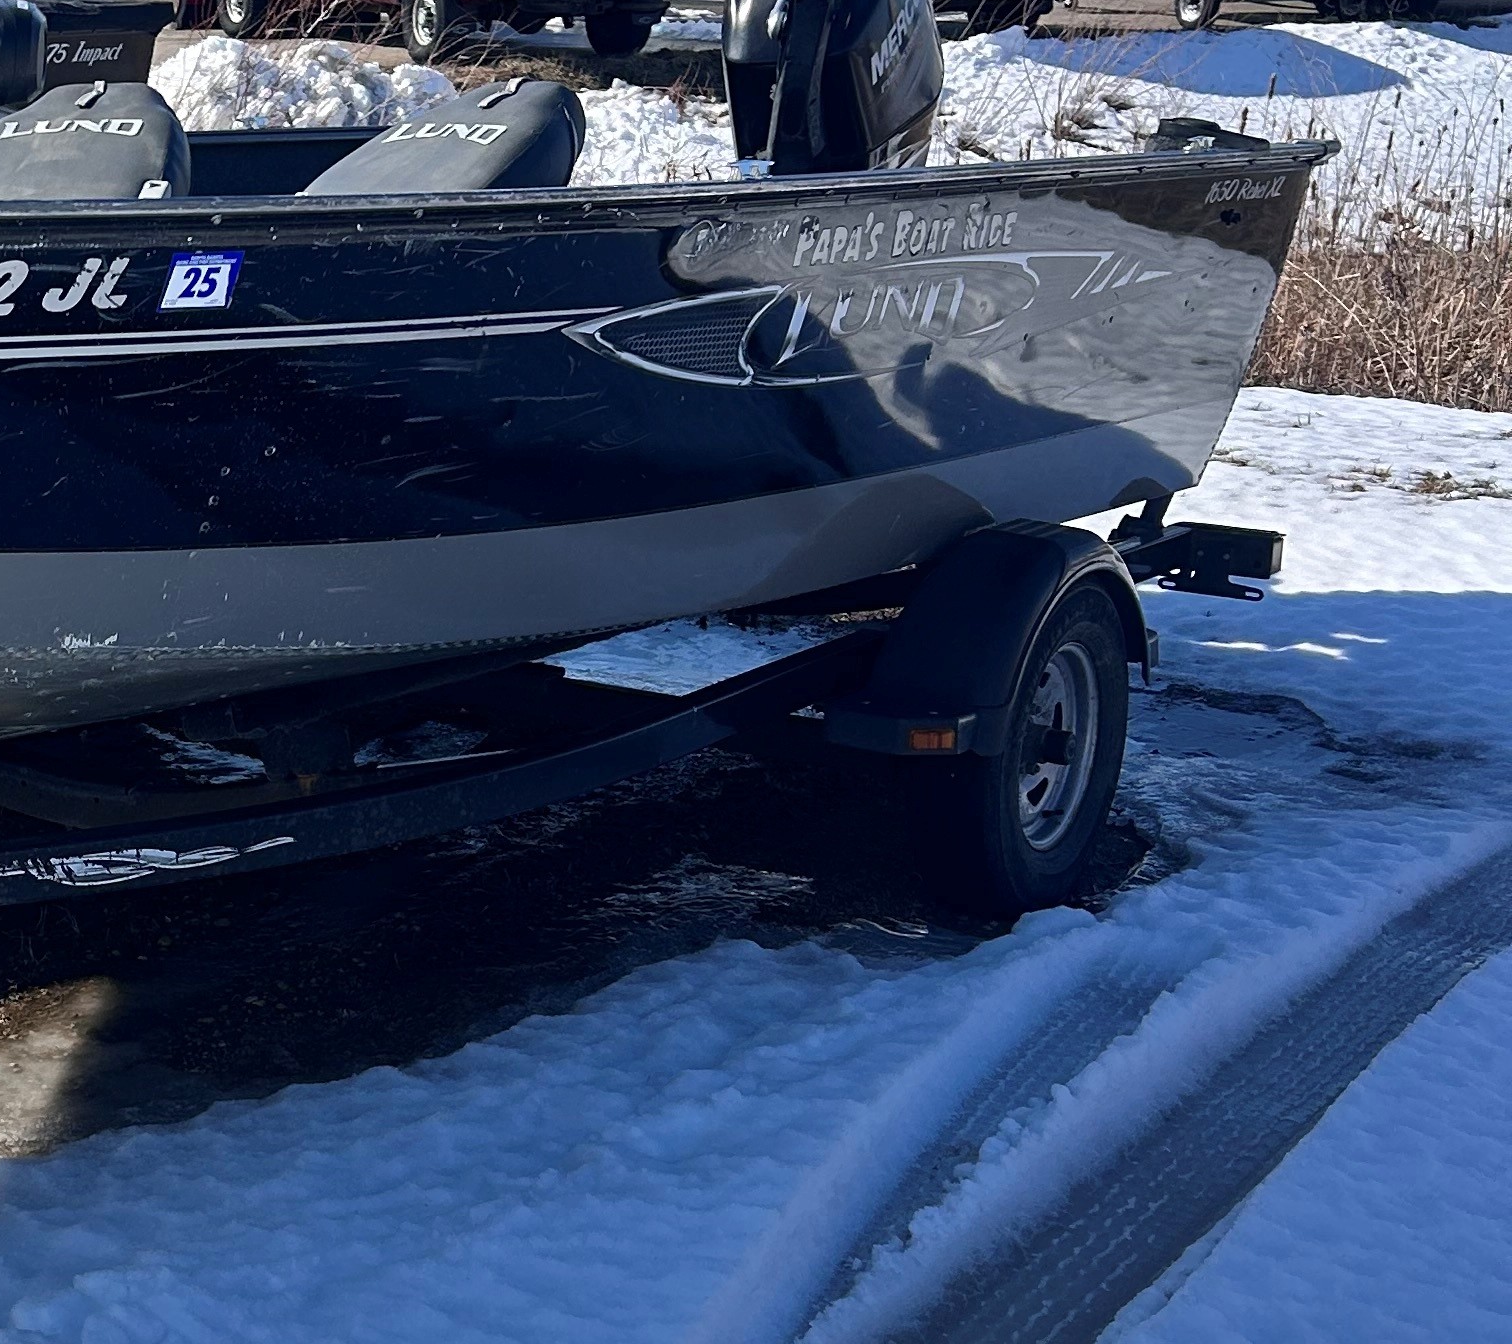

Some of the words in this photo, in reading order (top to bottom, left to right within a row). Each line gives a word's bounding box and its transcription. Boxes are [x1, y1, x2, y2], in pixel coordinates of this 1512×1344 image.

[71, 40, 124, 66] Impact
[381, 123, 508, 145] LUND
[41, 256, 130, 313] JL
[177, 266, 222, 298] 25
